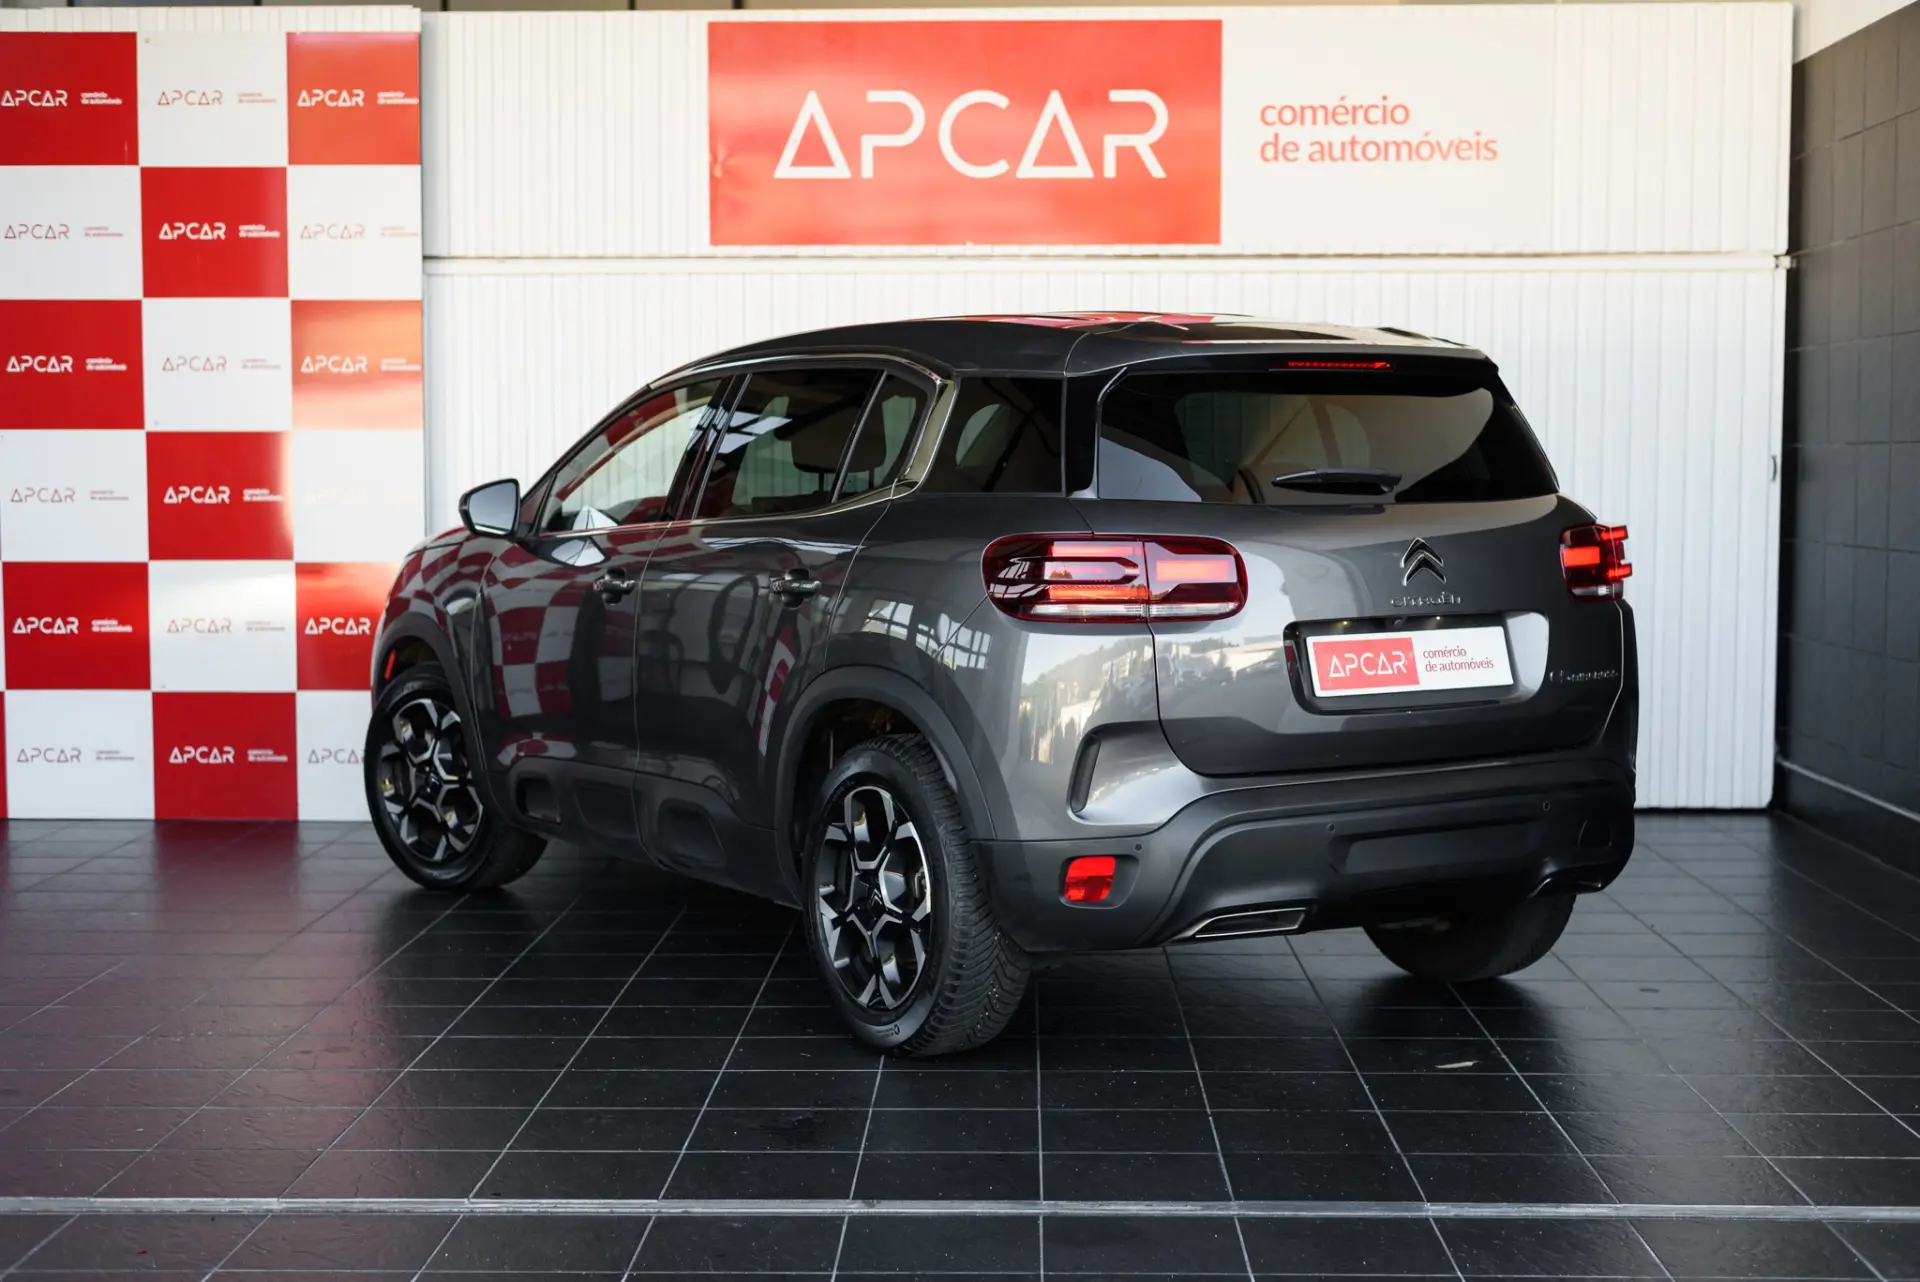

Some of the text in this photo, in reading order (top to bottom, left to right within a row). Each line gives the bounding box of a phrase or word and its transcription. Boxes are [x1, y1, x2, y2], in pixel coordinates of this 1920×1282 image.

[1, 89, 68, 107] APCAR
[157, 90, 223, 107] APCAR
[297, 89, 365, 107] APCAR
[1260, 95, 1410, 126] comércio
[773, 89, 1169, 180] APCAR
[1260, 131, 1498, 162] de automóveis
[4, 223, 70, 240] APCAR
[159, 222, 226, 241] APCAR
[300, 223, 365, 240] APCAR
[6, 355, 73, 373] APCAR
[162, 356, 227, 372] APCAR
[300, 355, 367, 373] APCAR
[10, 487, 76, 503] APCAR
[163, 486, 230, 504] APCAR
[12, 617, 79, 635] APCAR
[167, 618, 232, 634] APCAR
[305, 617, 371, 635] APCAR
[1423, 645, 1467, 659] comércio
[1329, 650, 1409, 678] APCAR
[1425, 657, 1494, 672] de automóveis
[17, 748, 82, 764] APCAR
[169, 746, 235, 764] APCAR
[308, 748, 365, 764] APCA
